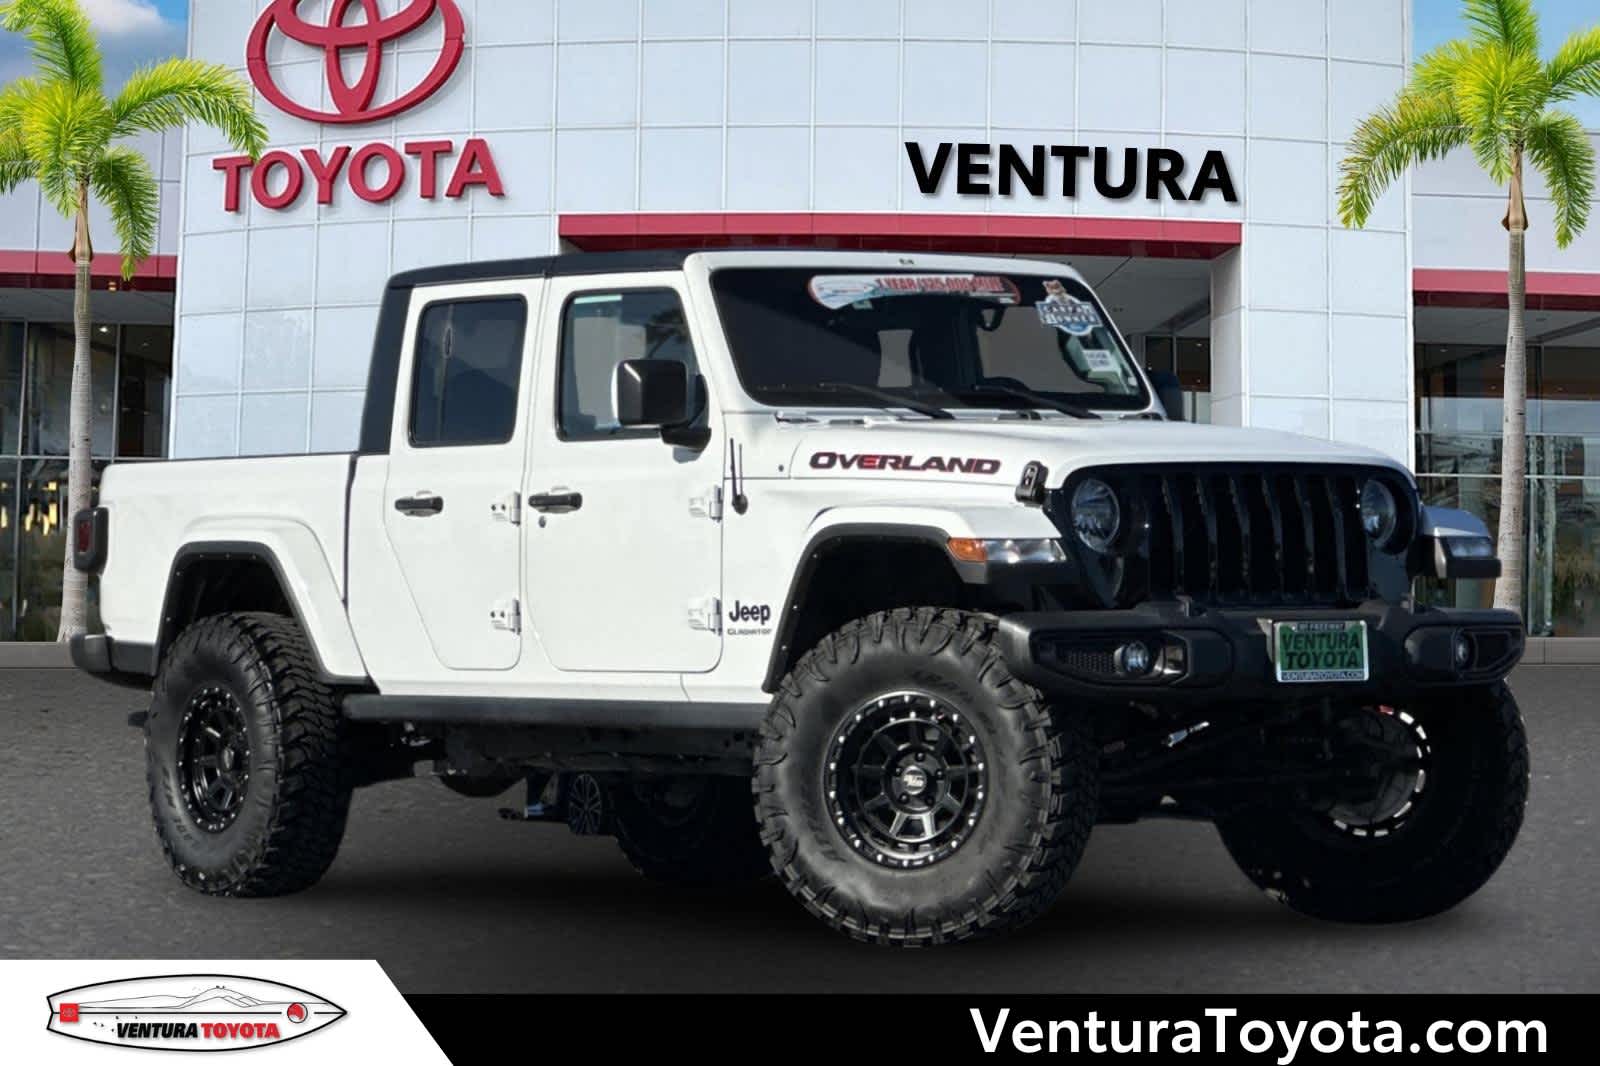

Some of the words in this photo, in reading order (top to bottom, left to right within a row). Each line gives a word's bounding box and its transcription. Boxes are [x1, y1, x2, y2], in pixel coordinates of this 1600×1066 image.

[212, 138, 505, 213] TOYOTA
[904, 142, 1239, 202] VENTURA
[809, 451, 1002, 475] OVERLAND
[729, 600, 771, 626] Jeep
[1282, 632, 1361, 649] VENTURA
[1286, 651, 1359, 669] TOYOTA
[1282, 671, 1363, 680] VENTURATOYOTA.COM
